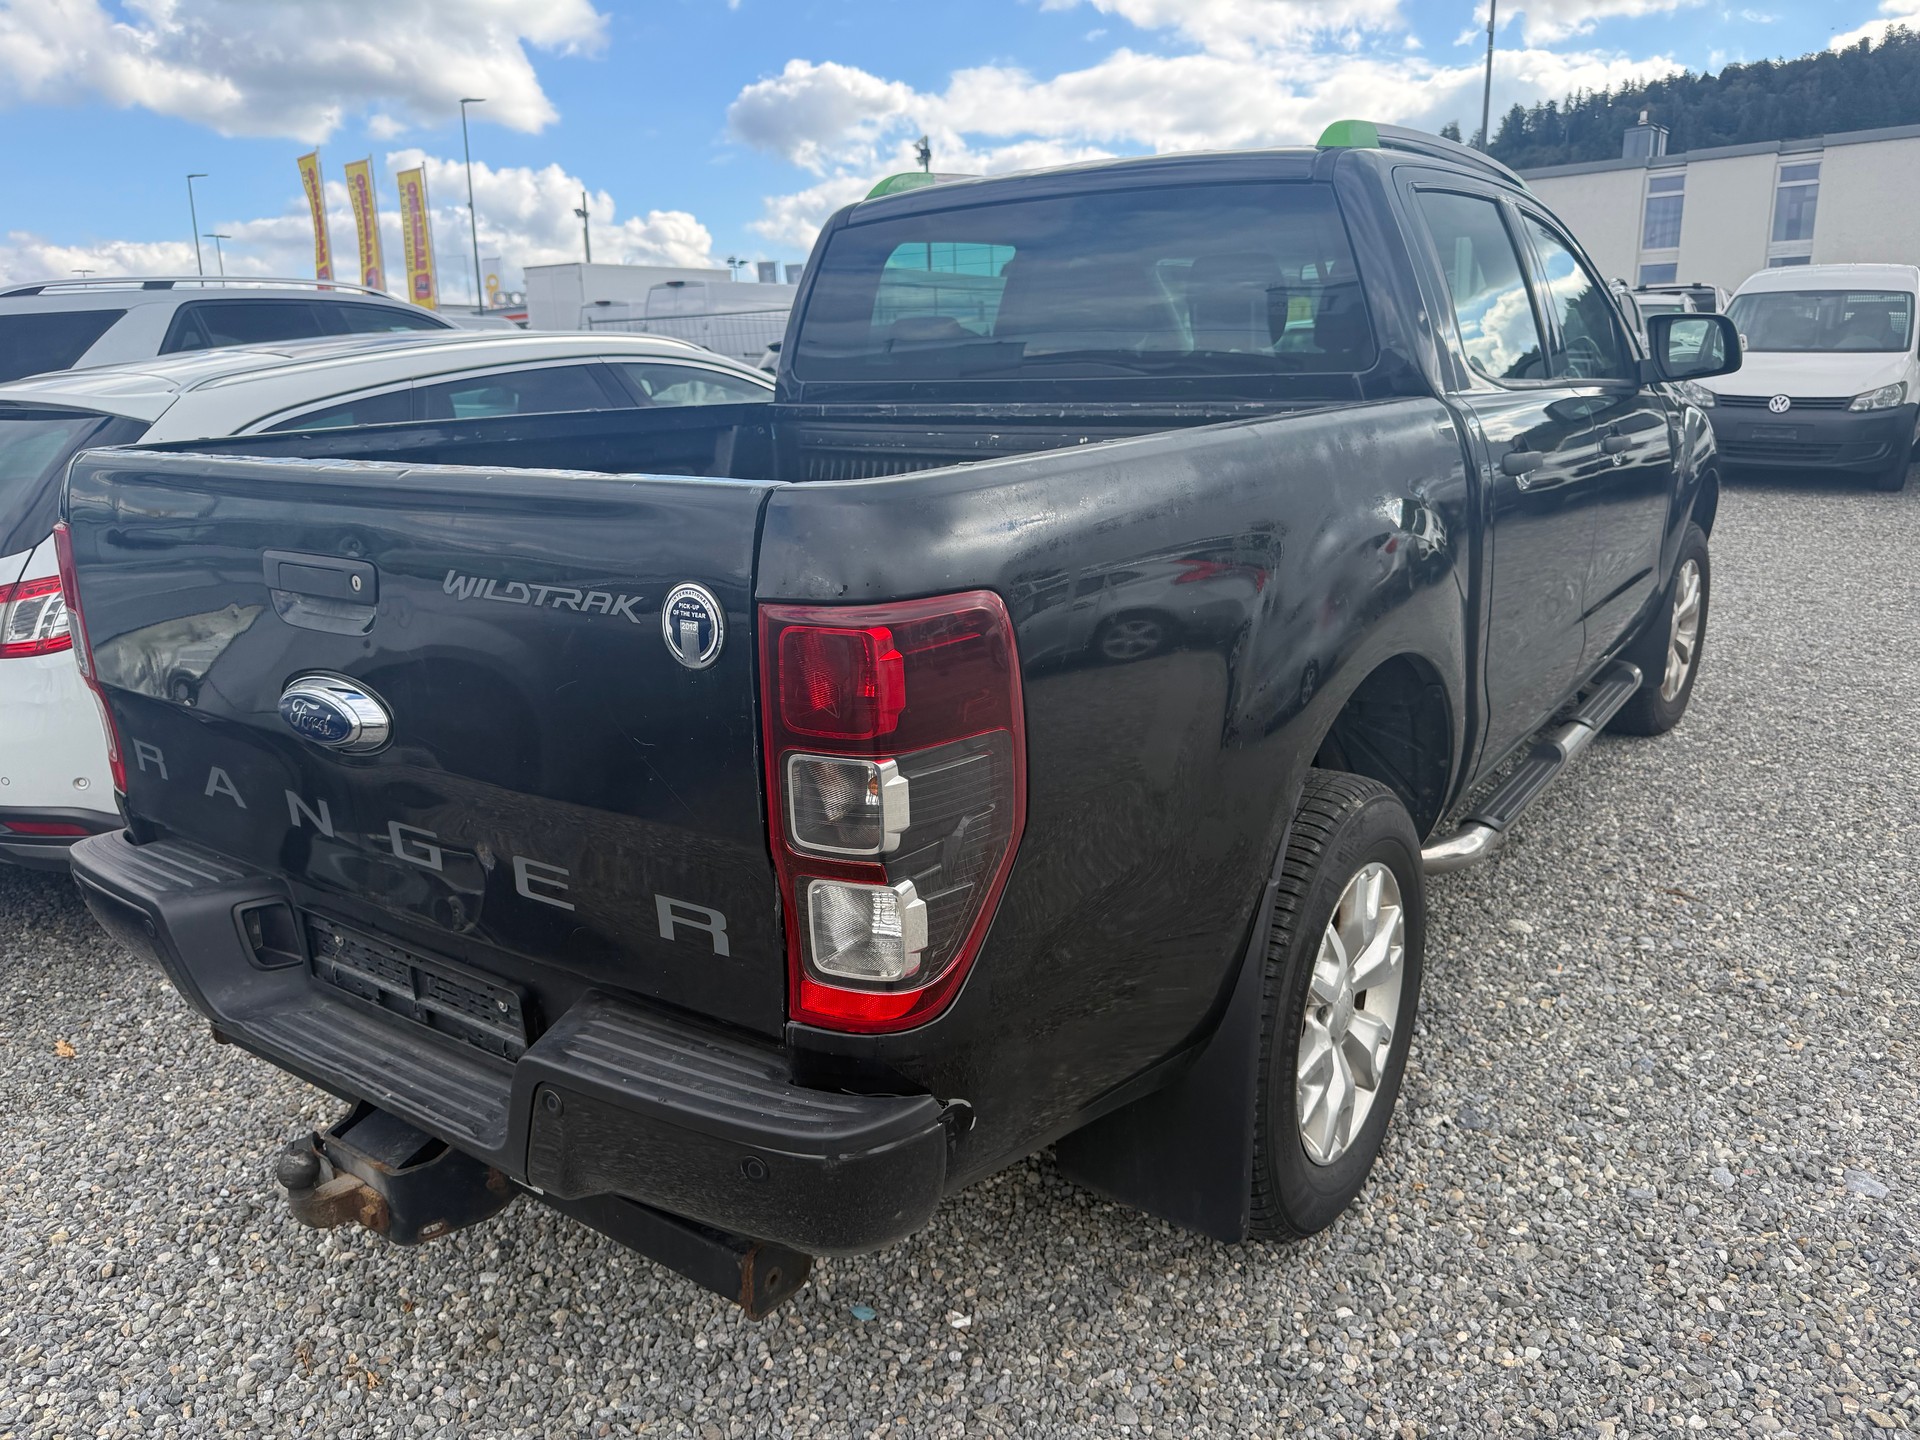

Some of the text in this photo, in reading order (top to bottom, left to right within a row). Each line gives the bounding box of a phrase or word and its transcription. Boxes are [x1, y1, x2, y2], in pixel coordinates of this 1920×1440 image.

[442, 569, 644, 624] WILDTRAK
[672, 590, 708, 605] INTERNATIONAL
[678, 602, 700, 611] PICK-UP
[680, 610, 691, 618] THE
[691, 611, 706, 619] YEAR
[681, 622, 697, 631] 2013
[289, 698, 332, 736] Ford
